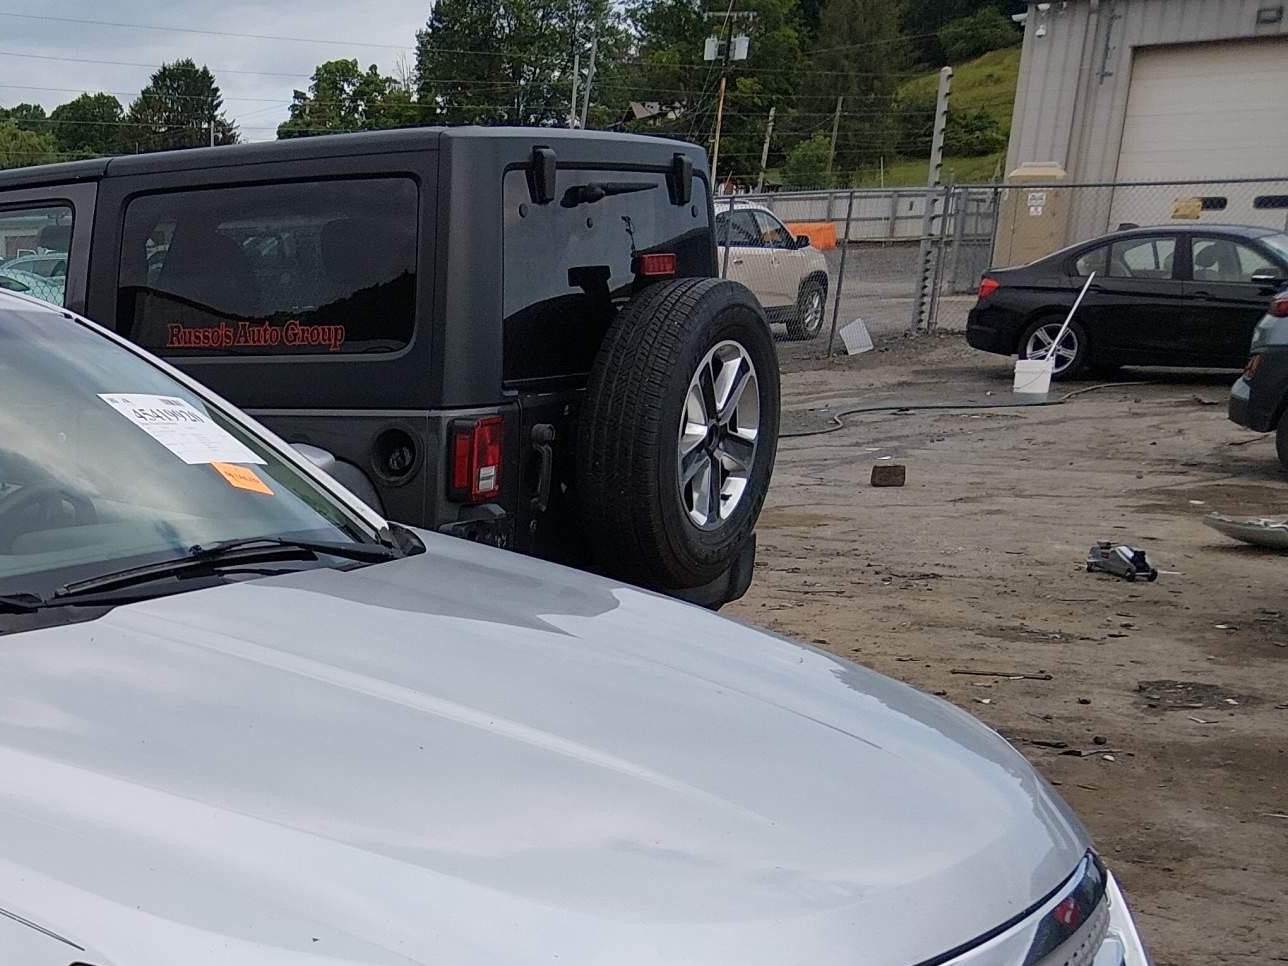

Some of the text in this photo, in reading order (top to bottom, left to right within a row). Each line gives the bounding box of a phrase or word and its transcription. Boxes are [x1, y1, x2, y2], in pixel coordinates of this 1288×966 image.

[167, 320, 345, 351] Russo's Auto Group
